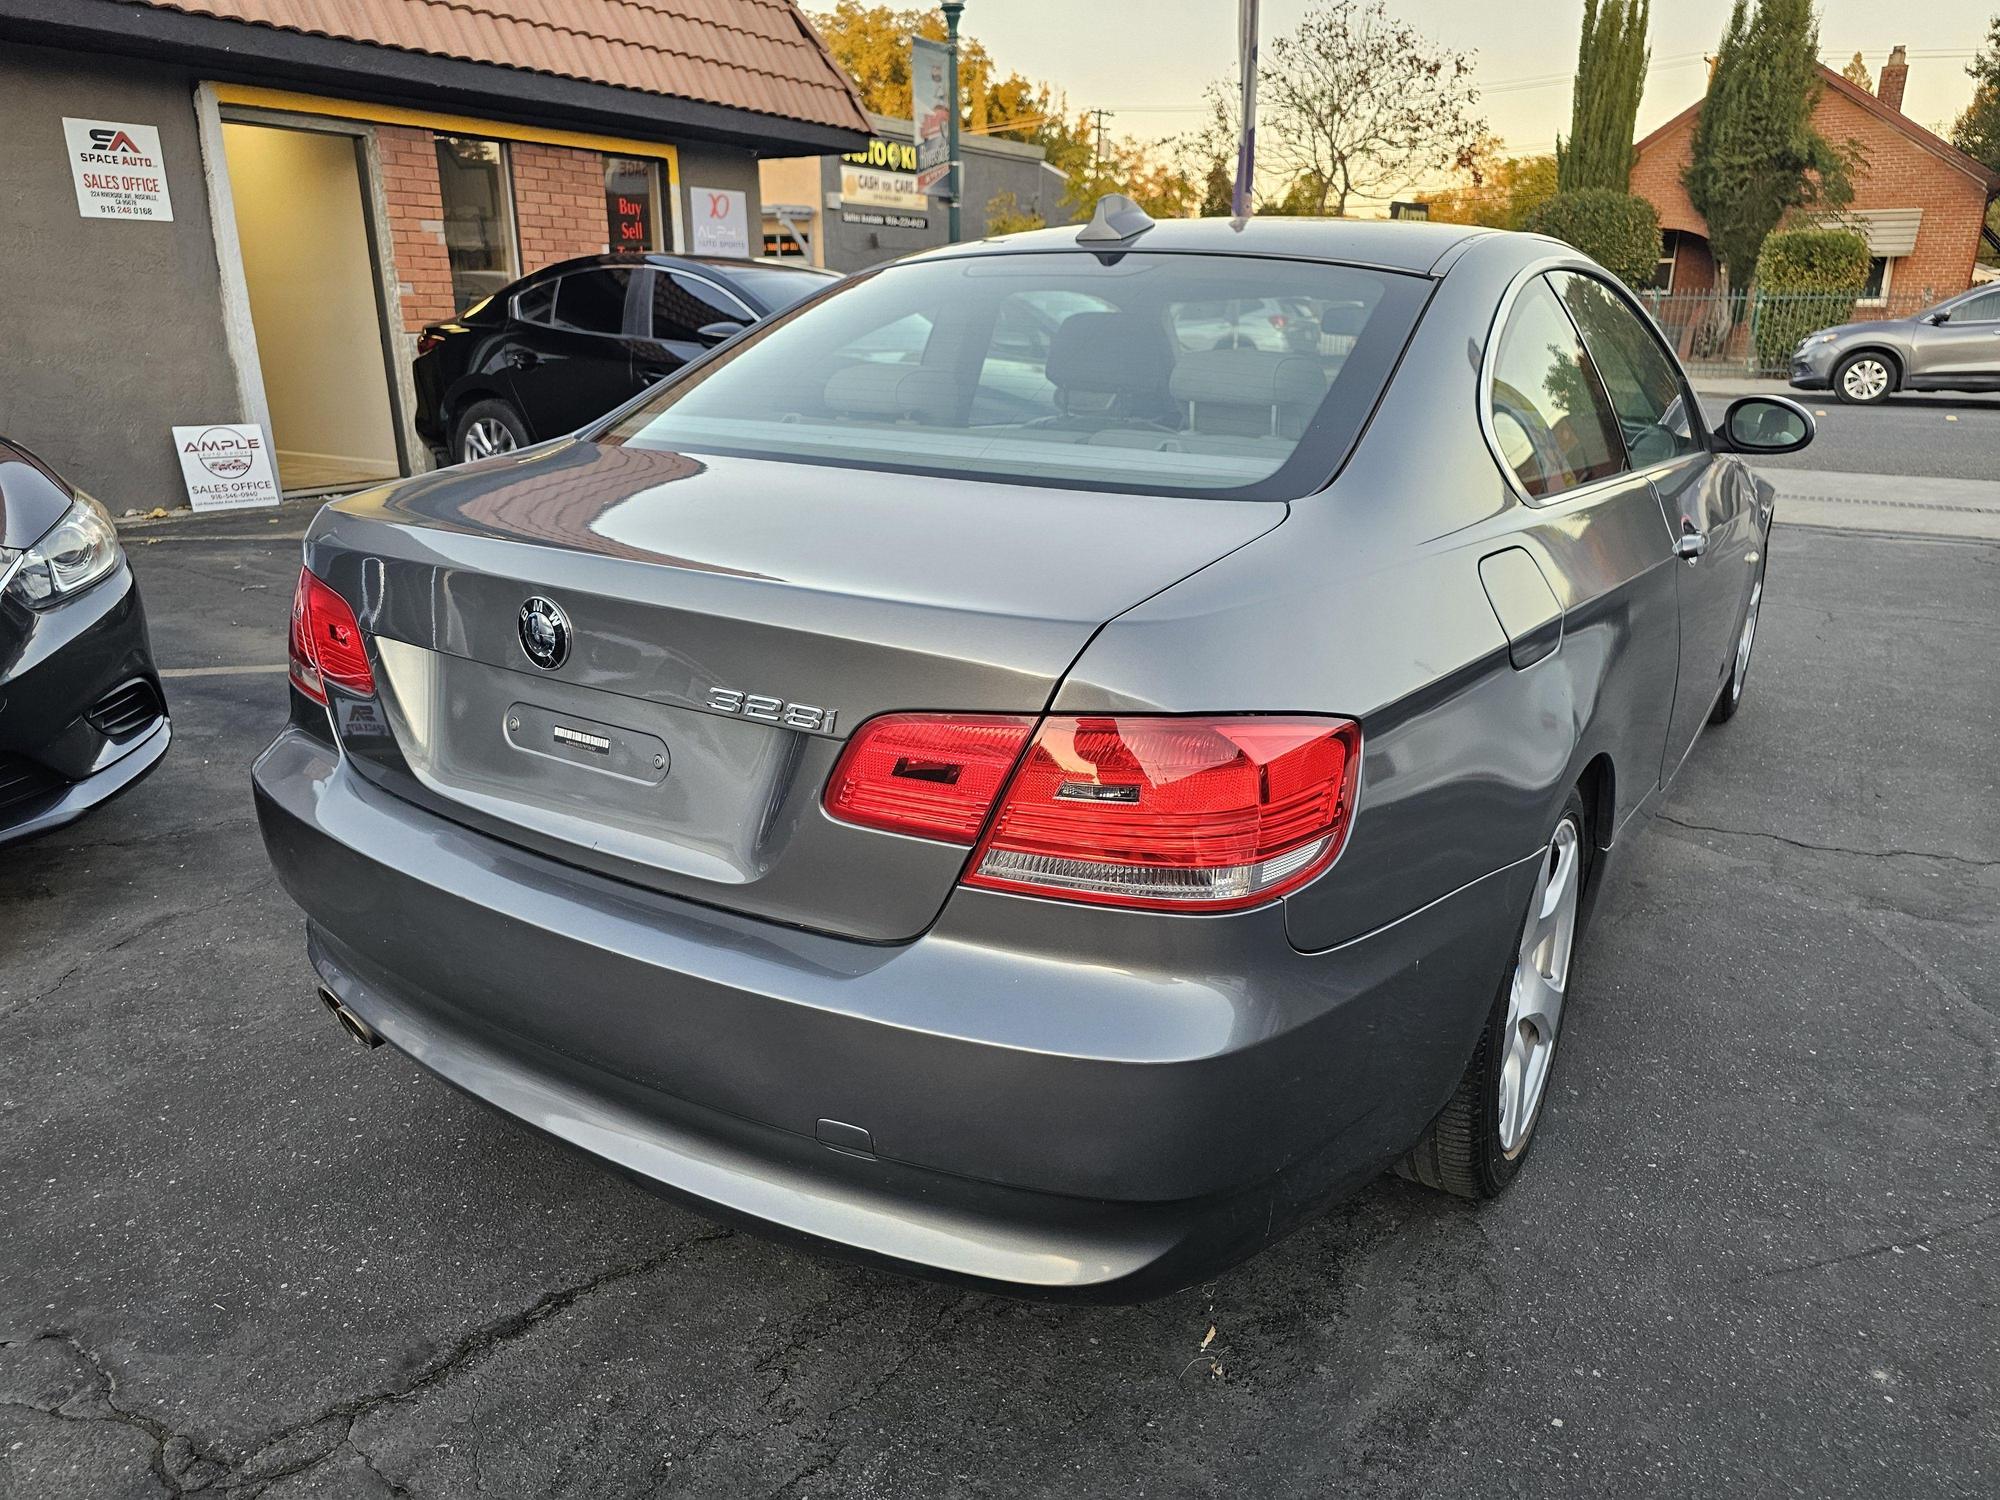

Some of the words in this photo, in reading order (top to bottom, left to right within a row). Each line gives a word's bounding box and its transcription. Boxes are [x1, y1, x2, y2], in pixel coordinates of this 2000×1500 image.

[80, 152, 119, 165] SPACE
[122, 156, 153, 168] AUTO
[83, 173, 120, 190] SALES
[122, 176, 160, 193] OFFICE
[858, 175, 879, 190] CASH
[895, 179, 914, 193] CARS
[100, 205, 116, 214] 916
[117, 206, 132, 215] 248
[133, 207, 153, 216] 0168
[618, 197, 642, 221] Buy
[621, 222, 644, 240] Sell
[183, 438, 260, 453] AMPLE
[191, 483, 229, 495] SALES
[231, 480, 273, 492] OFFICE
[520, 599, 562, 627] BMW
[705, 685, 838, 735] 328i
